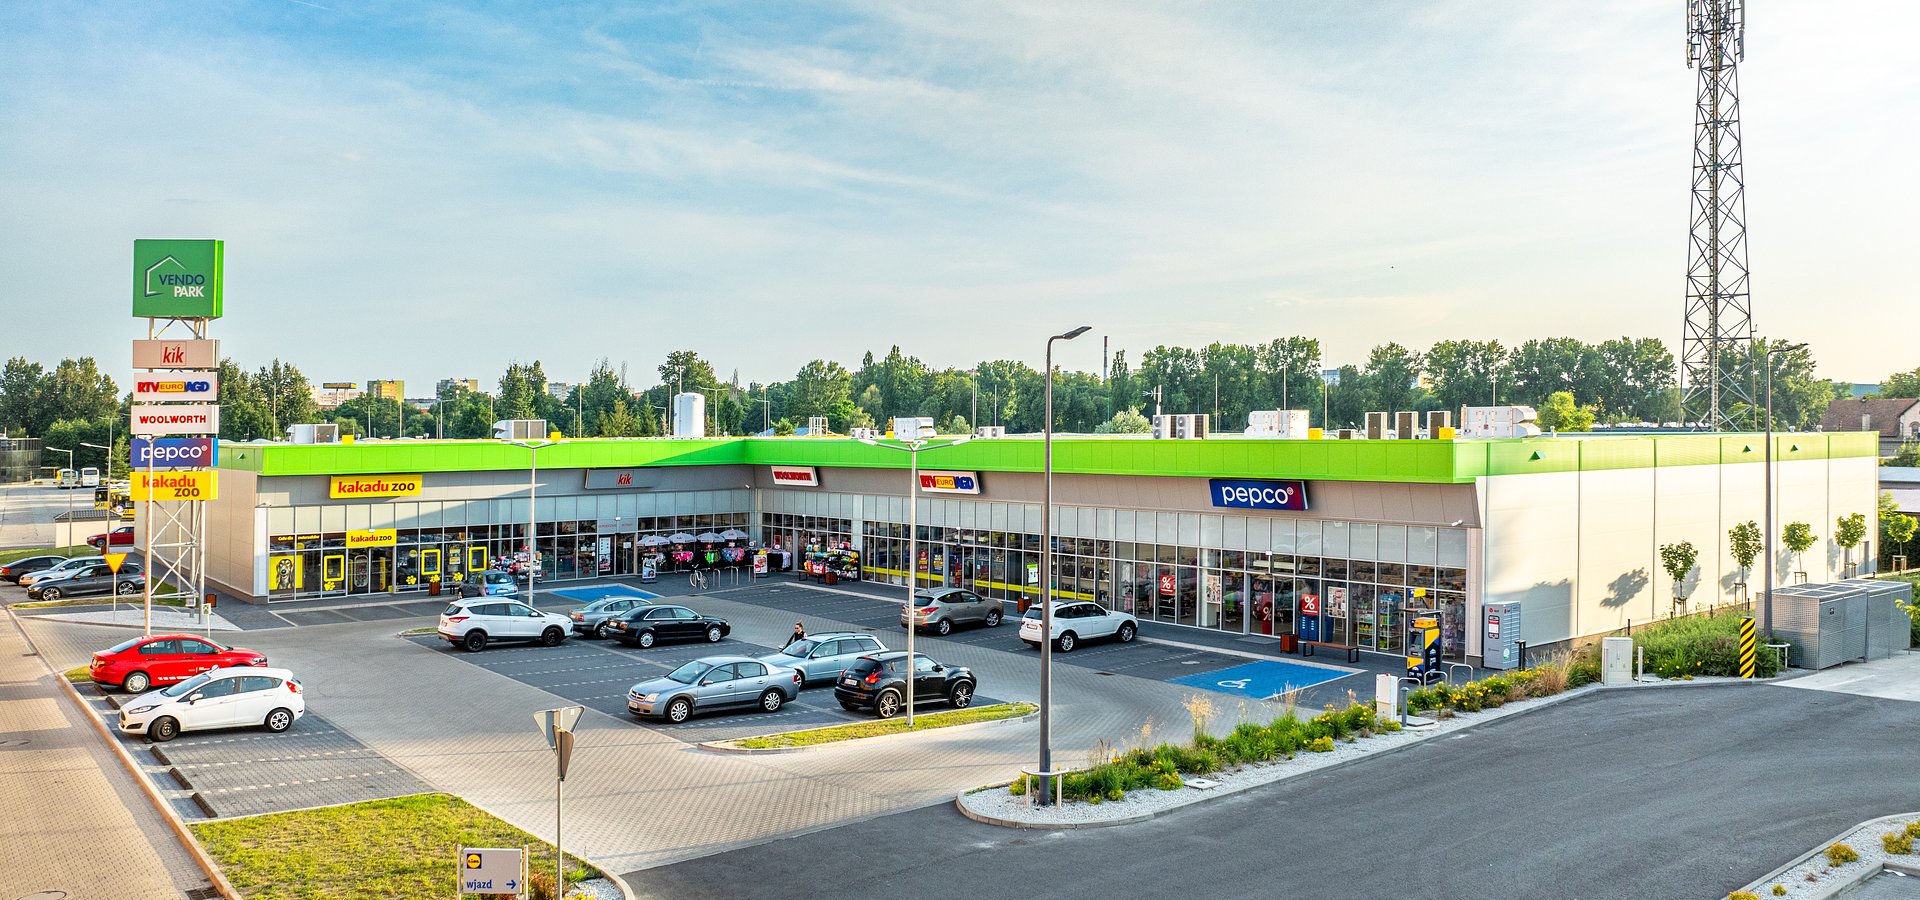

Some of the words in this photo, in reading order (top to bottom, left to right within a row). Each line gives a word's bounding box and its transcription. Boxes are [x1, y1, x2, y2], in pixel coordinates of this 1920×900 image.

[159, 274, 205, 286] VENDO
[174, 286, 204, 298] PARK
[163, 346, 184, 364] kik
[137, 381, 159, 393] RTV
[185, 381, 210, 392] AGD
[139, 415, 207, 424] WOOLWORTH
[142, 475, 196, 488] kakadu
[617, 473, 632, 486] kik
[936, 478, 954, 486] EURO
[174, 487, 200, 498] zoo
[338, 480, 389, 494] kakadu
[391, 482, 415, 492] zoo
[350, 534, 379, 543] kakadu
[467, 879, 492, 891] wjazd
